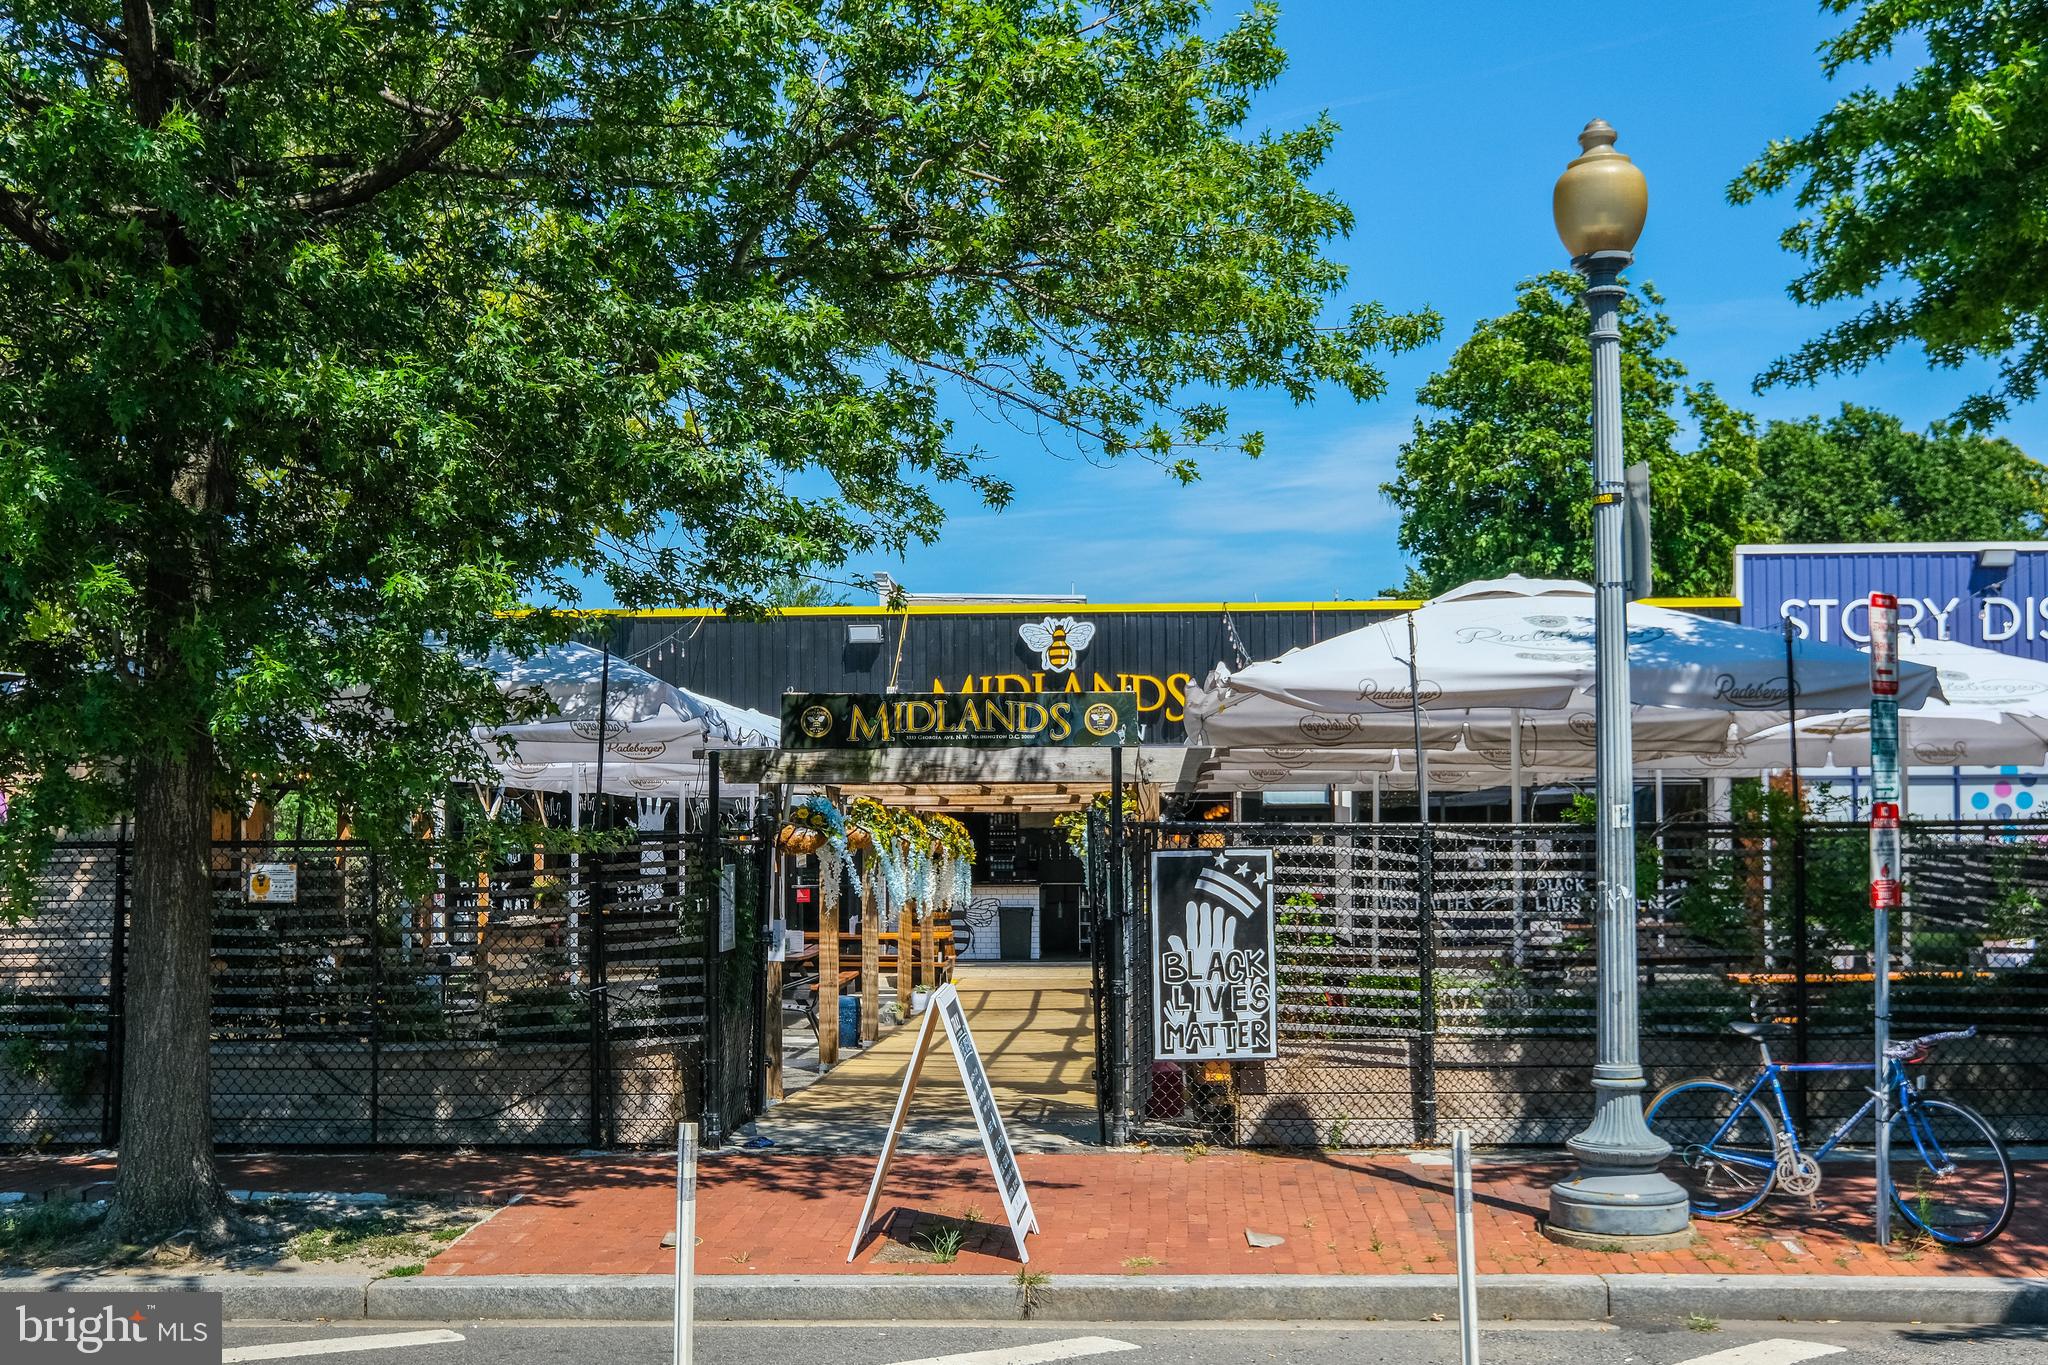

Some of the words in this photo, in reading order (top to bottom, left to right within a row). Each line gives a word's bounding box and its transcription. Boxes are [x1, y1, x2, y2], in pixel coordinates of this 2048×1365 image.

[1780, 598, 1960, 642] STORY
[1356, 678, 1441, 704] Radebeger
[1713, 674, 1798, 702] Radeberge
[846, 698, 1072, 742] MIDLANDS
[1535, 895, 1581, 914] LIVES
[1162, 949, 1269, 985] BLACK
[1171, 982, 1270, 1015] LIVES
[1163, 1018, 1270, 1050] MATTER
